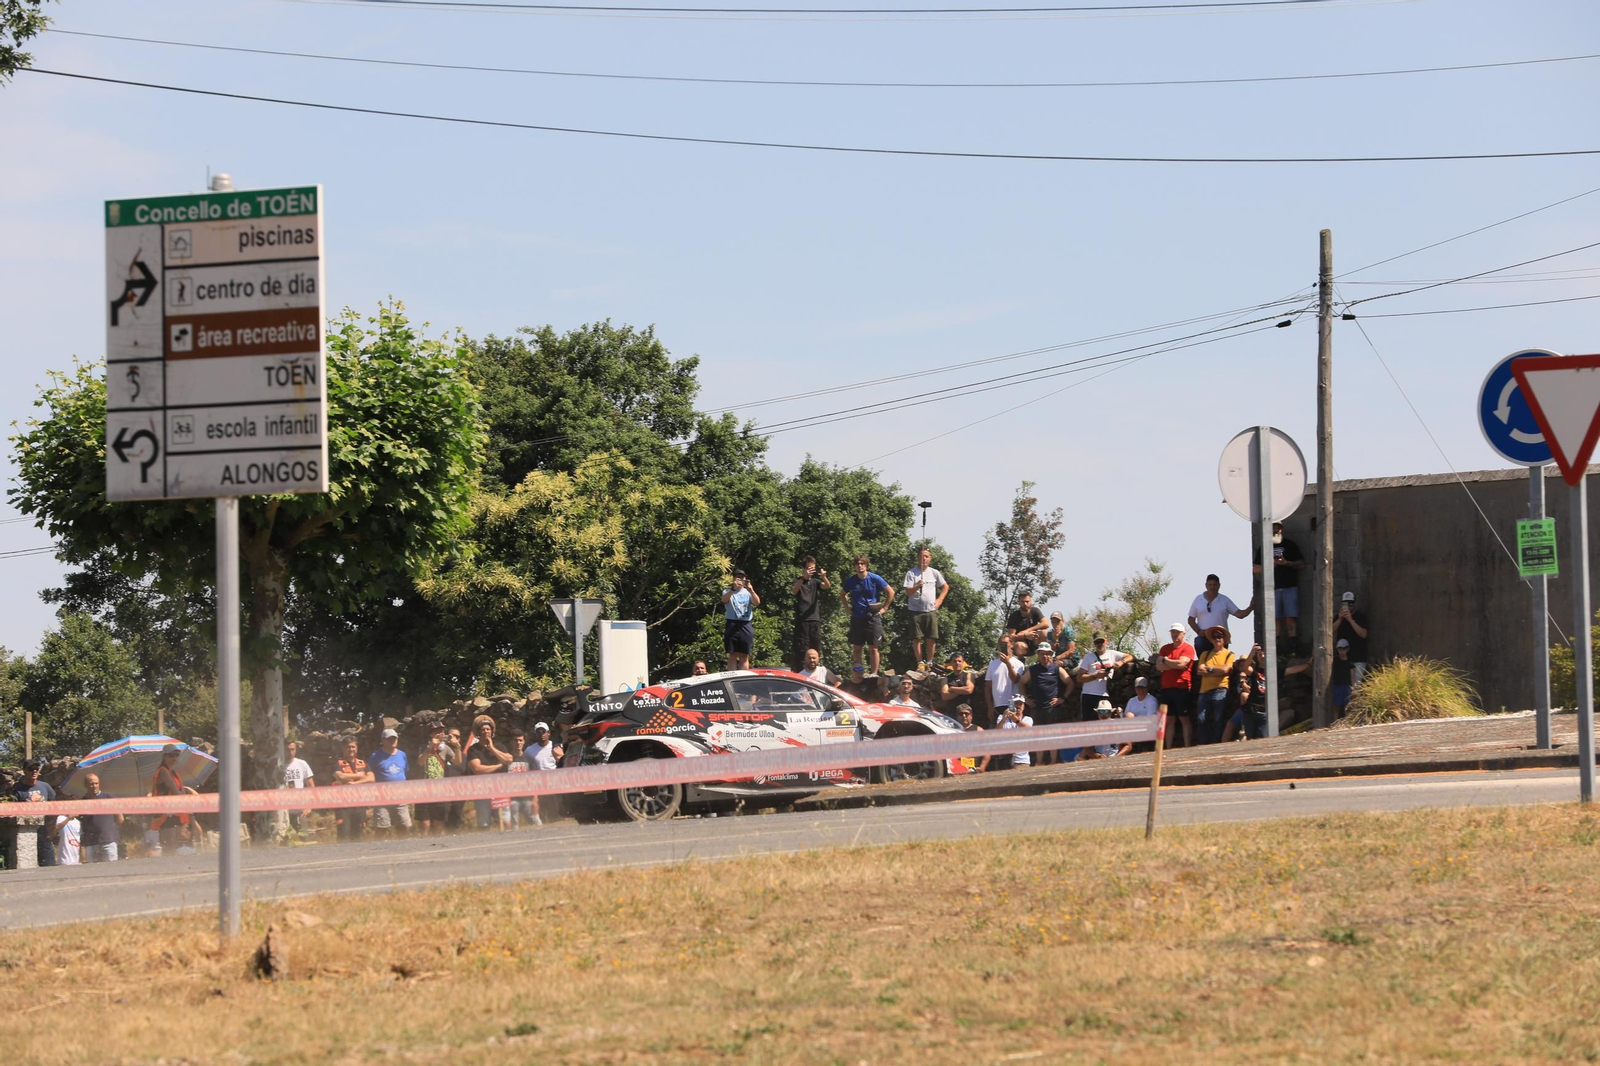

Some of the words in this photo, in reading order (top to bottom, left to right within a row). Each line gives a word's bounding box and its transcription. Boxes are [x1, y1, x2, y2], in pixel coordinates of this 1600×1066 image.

[135, 202, 222, 223] Concello
[227, 198, 252, 216] de
[256, 189, 314, 215] TOÉN
[238, 224, 315, 252] piscinas
[196, 278, 254, 300] centro
[260, 275, 282, 297] de
[197, 325, 232, 347] área
[236, 320, 316, 345] recreativa
[207, 417, 256, 439] escola
[265, 414, 318, 436] infantil
[220, 461, 319, 485] ALONGOS
[633, 698, 661, 706] texas
[671, 691, 685, 708] 2
[701, 697, 725, 705] Rozada
[708, 713, 770, 721] SAFETOP
[840, 712, 851, 725] 2
[726, 730, 758, 738] Bermúdez
[759, 730, 775, 738] Ulloa
